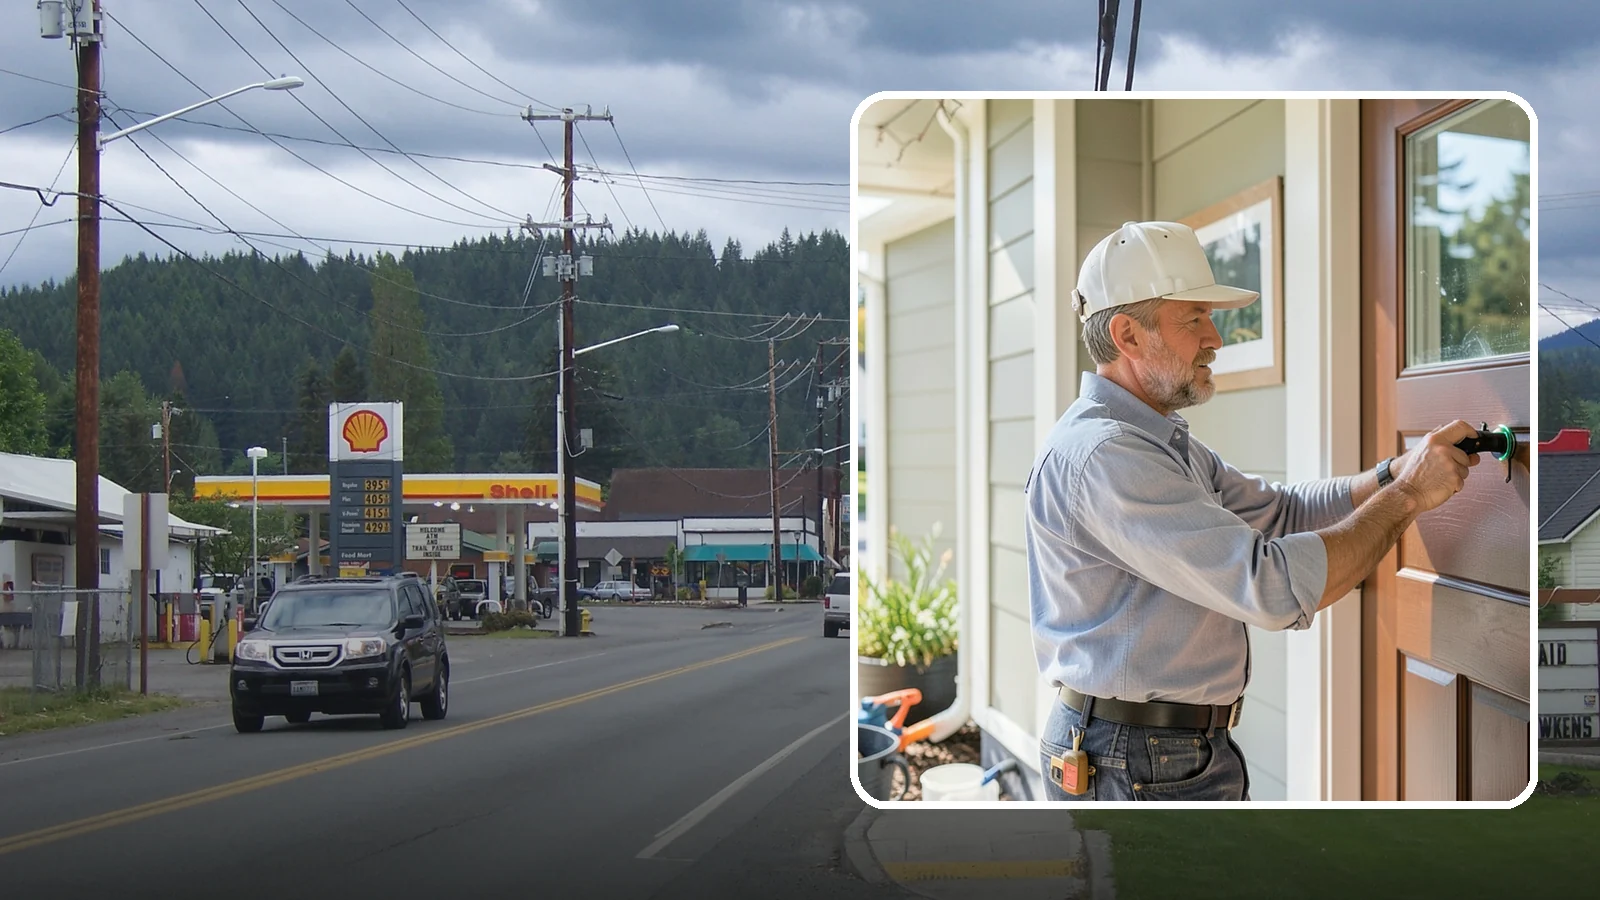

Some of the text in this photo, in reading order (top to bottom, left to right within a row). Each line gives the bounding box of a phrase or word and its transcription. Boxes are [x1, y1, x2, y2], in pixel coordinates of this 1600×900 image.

[366, 480, 383, 490] 395
[490, 484, 547, 498] Shell
[366, 494, 383, 504] 405
[366, 508, 383, 518] 415
[366, 522, 383, 532] 429
[1538, 643, 1566, 666] AID
